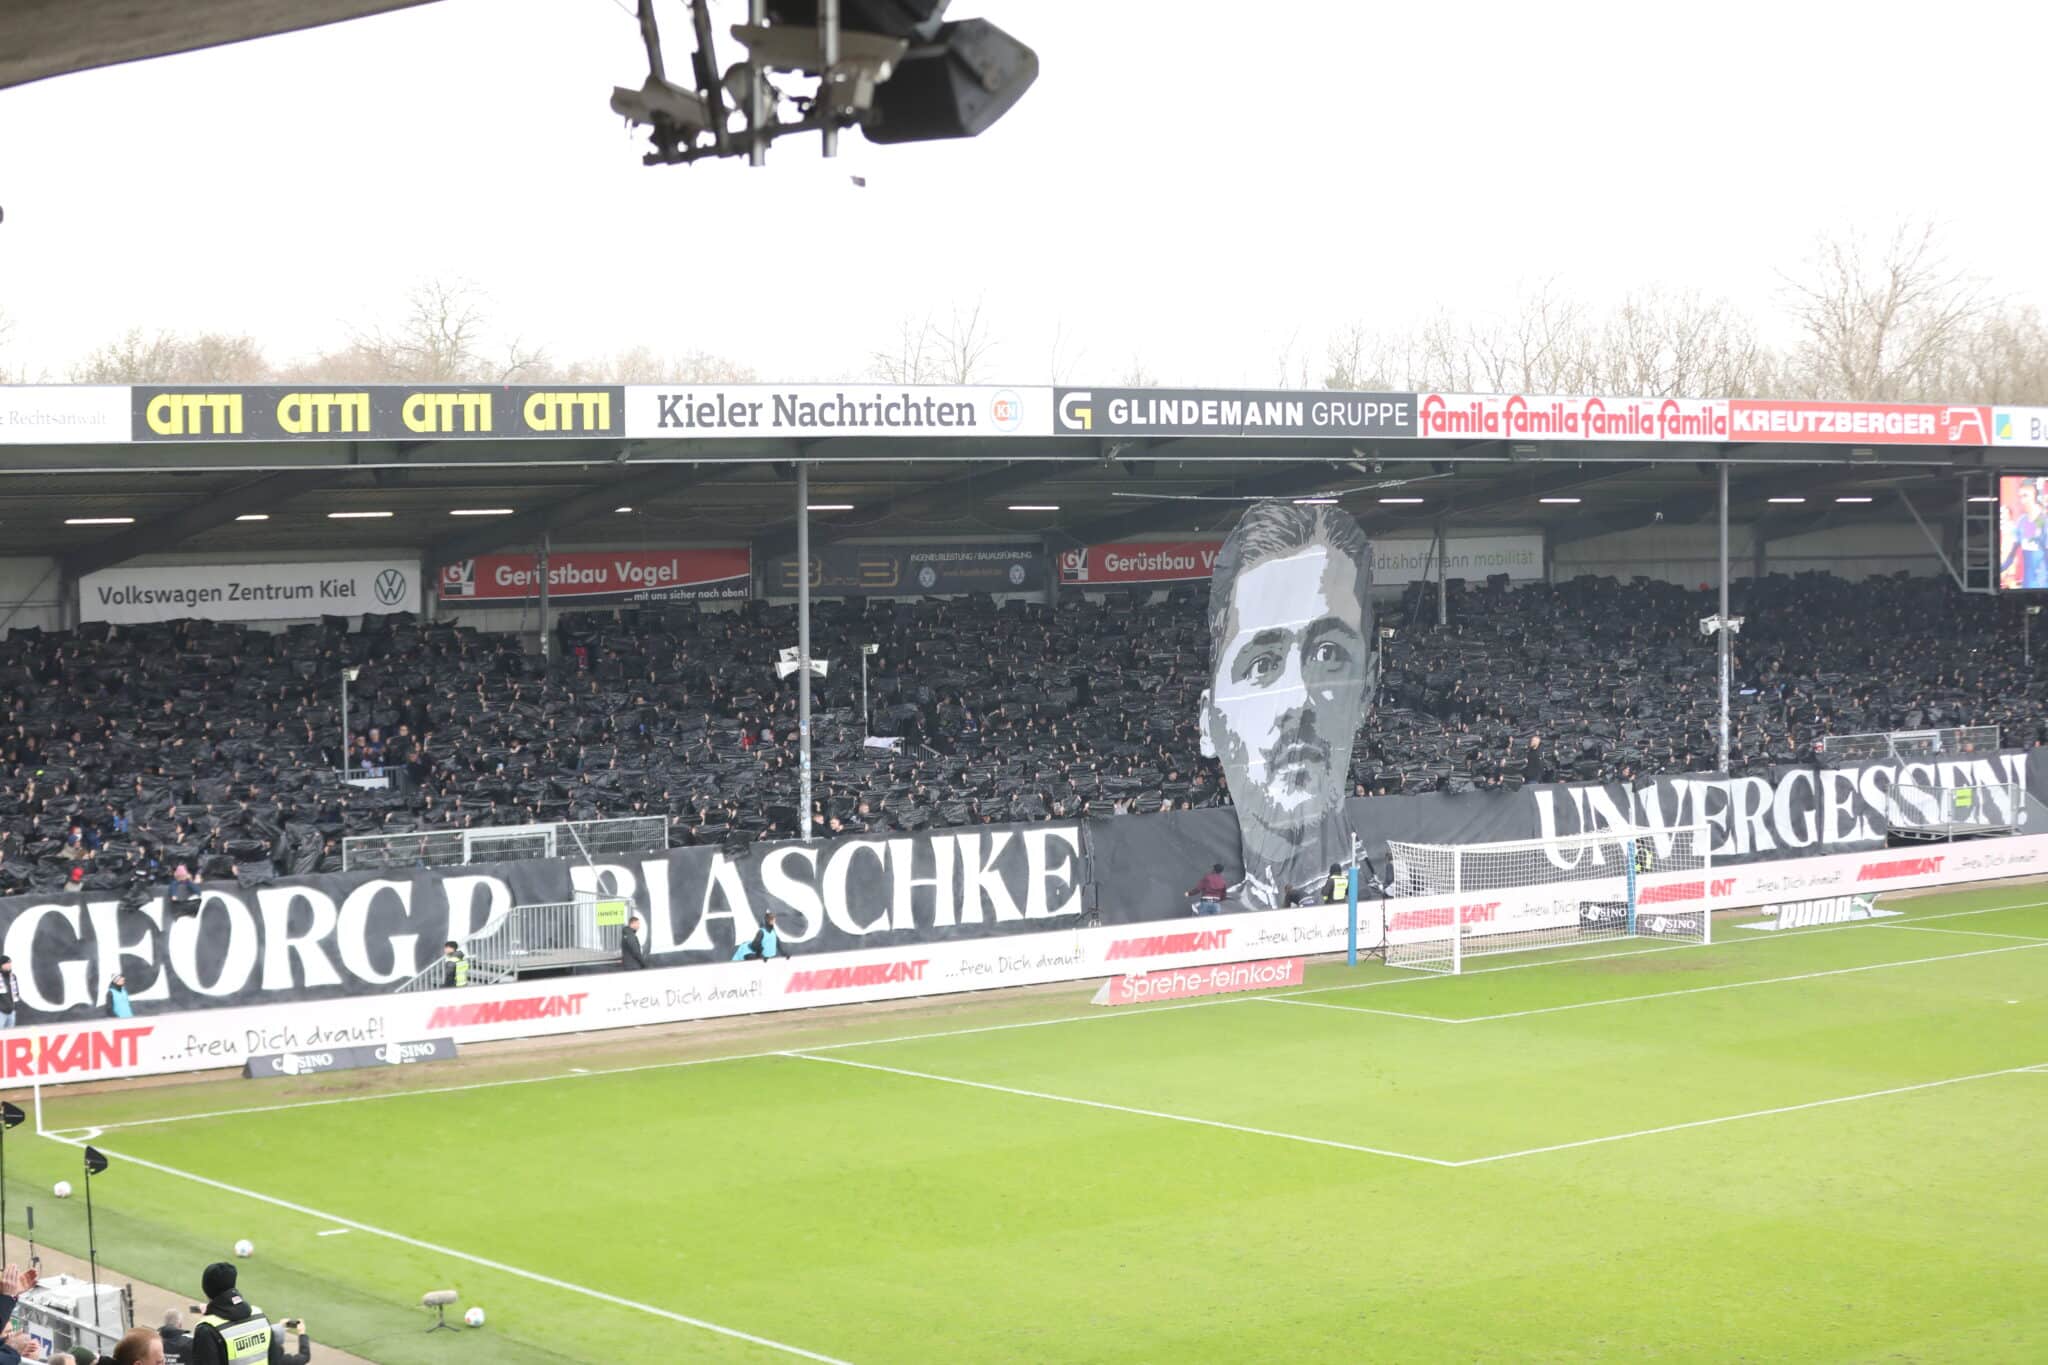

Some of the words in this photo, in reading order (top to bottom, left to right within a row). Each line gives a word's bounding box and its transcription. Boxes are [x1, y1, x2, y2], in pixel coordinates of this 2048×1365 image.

[657, 394, 763, 428] Kieler
[772, 393, 977, 428] Nachrichten
[1108, 399, 1304, 426] GLINDEMANN
[1311, 401, 1409, 427] GRUPPE
[1419, 394, 1498, 437] famila
[1502, 395, 1578, 438] famila
[1581, 398, 1654, 439] famila
[1657, 399, 1727, 440] famila
[1733, 409, 1936, 435] KREUTZBERGER
[1104, 552, 1196, 573] Gerüstbau
[1473, 549, 1534, 566] mobilität
[614, 558, 678, 589] Vogel
[98, 584, 222, 608] Volkswagen
[228, 582, 314, 602] Zentrum
[320, 579, 356, 599] Kiel
[1534, 754, 2027, 871] UNVERGESSEN!
[2, 878, 419, 1012] GEORG
[569, 826, 1082, 958] BLASCHKE
[826, 959, 930, 988] MARKANT
[998, 953, 1031, 974] Dich
[472, 992, 589, 1024] MARKANT
[665, 983, 702, 1009] Dich
[707, 979, 763, 1002] drauf!
[0, 1026, 155, 1079] RKANT
[161, 1034, 237, 1060] ...freu
[246, 1025, 297, 1051] Dich
[307, 1017, 385, 1047] drauf!
[375, 1041, 436, 1065] CSINO
[272, 1052, 334, 1076] CSINO
